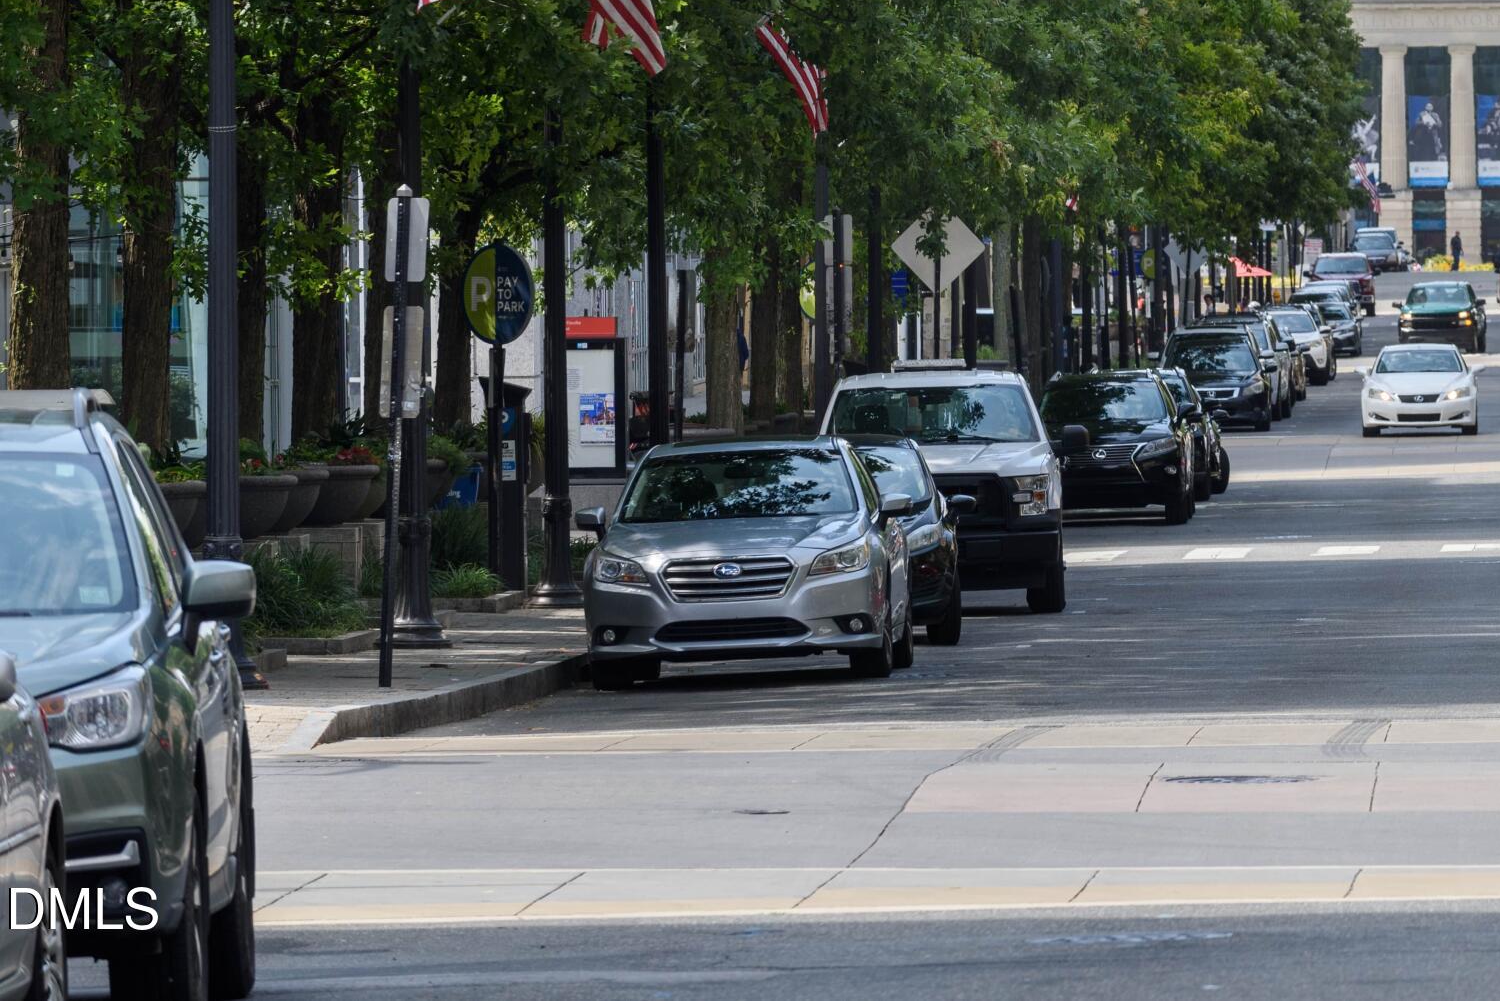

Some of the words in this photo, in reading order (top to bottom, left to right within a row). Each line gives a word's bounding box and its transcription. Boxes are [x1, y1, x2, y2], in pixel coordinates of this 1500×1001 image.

[497, 276, 518, 287] PAY
[471, 276, 492, 311] P
[497, 289, 512, 300] TO
[497, 301, 525, 312] PARK
